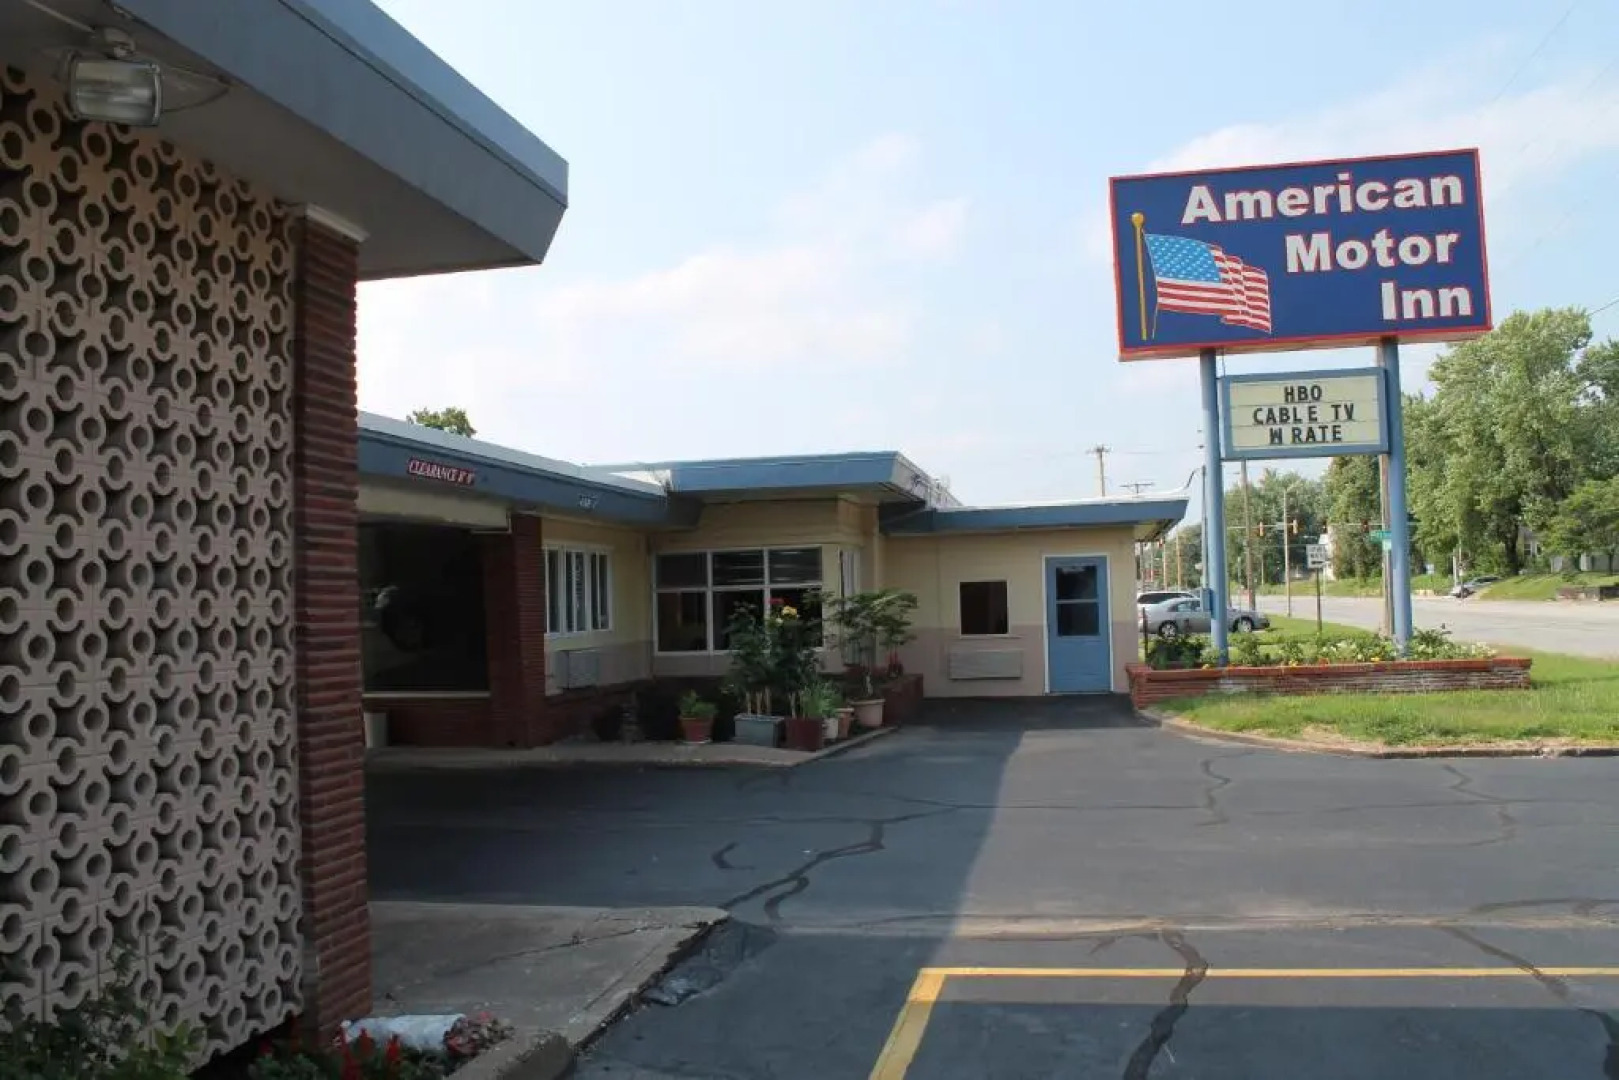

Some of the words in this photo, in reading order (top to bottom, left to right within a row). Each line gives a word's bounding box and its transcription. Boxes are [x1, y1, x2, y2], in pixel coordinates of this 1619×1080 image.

[1181, 171, 1463, 225] American
[1285, 228, 1460, 273] Motor
[1380, 280, 1473, 321] Inn
[1284, 385, 1323, 403] HBO
[1252, 405, 1318, 426] CABLE
[1331, 402, 1355, 422] TV
[1291, 425, 1343, 444] RATE
